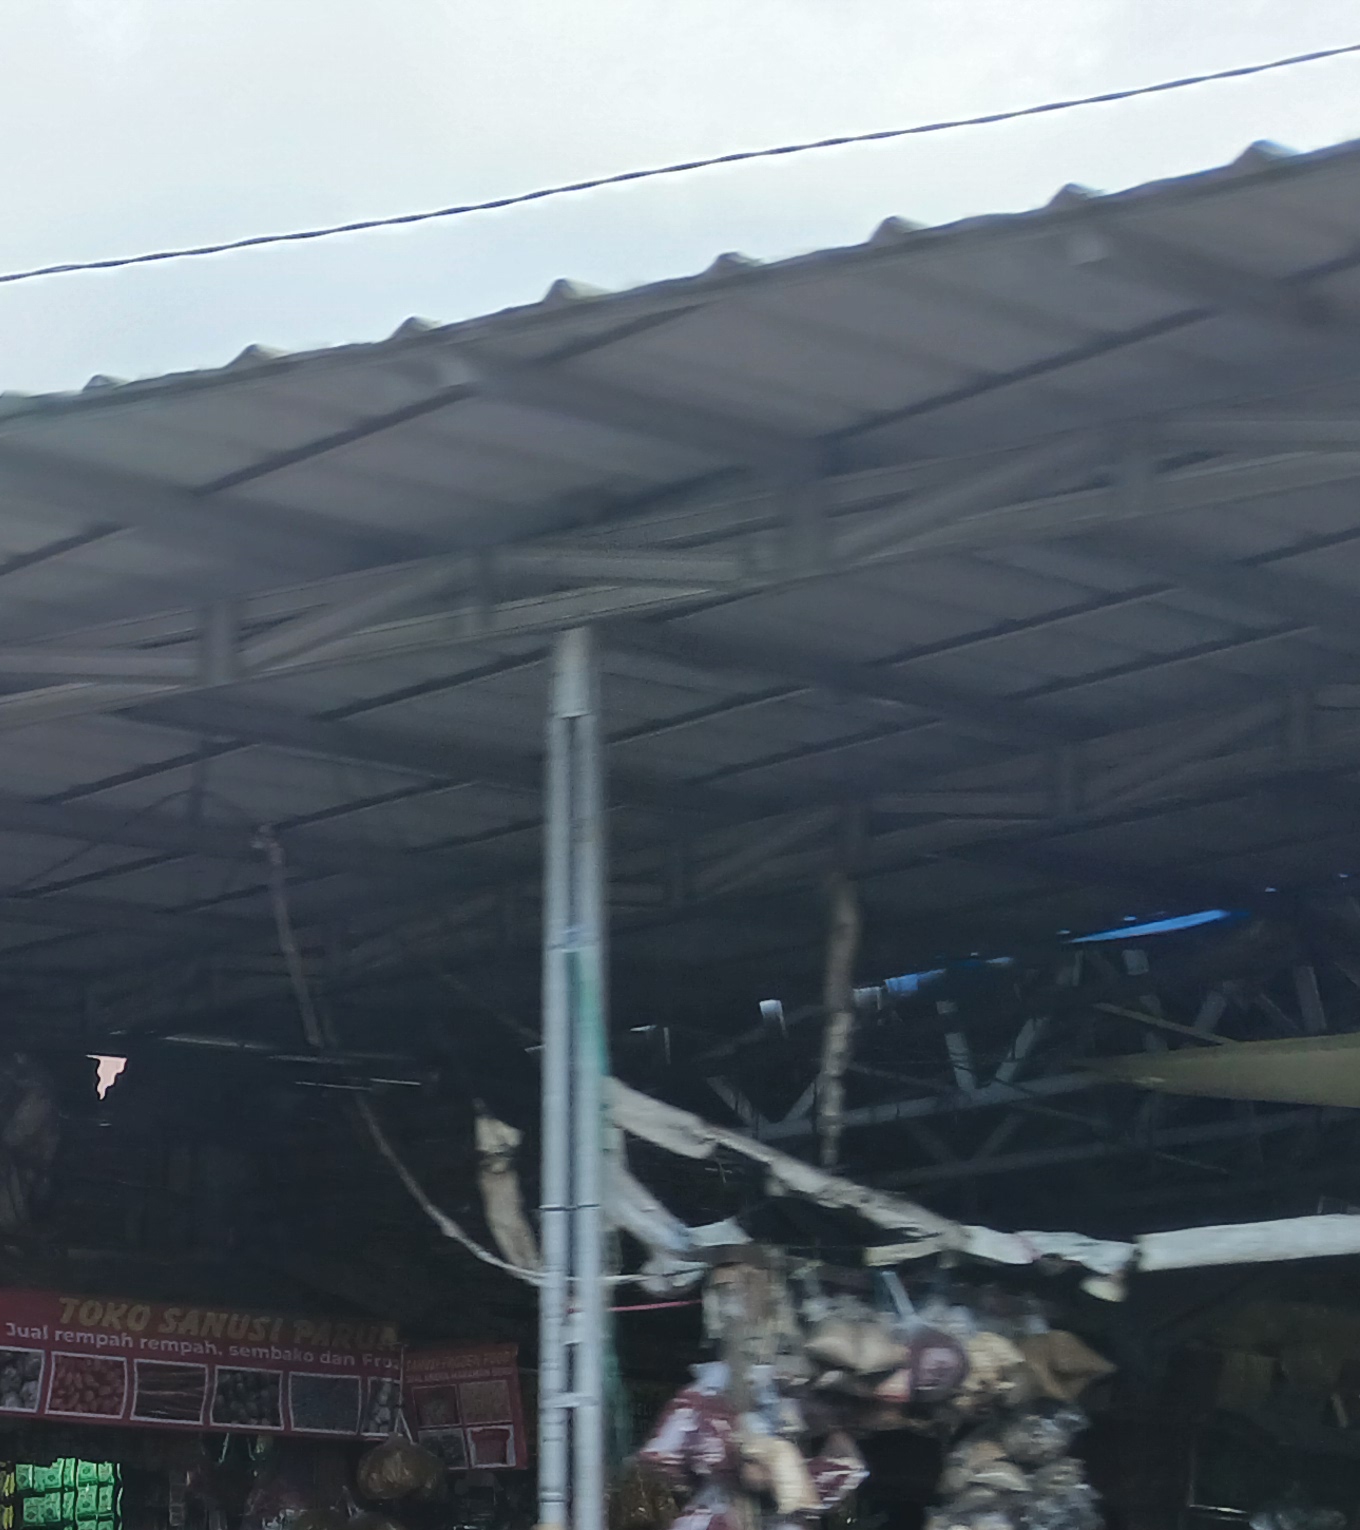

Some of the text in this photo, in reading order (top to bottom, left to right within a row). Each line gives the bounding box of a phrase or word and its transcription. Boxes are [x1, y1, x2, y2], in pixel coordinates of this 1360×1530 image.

[58, 1296, 152, 1333] TOKO
[158, 1306, 284, 1343] SANUSI
[5, 1321, 49, 1341] Jual
[54, 1329, 134, 1349] rempah
[229, 1344, 314, 1363] sembako
[320, 1351, 355, 1366] dan
